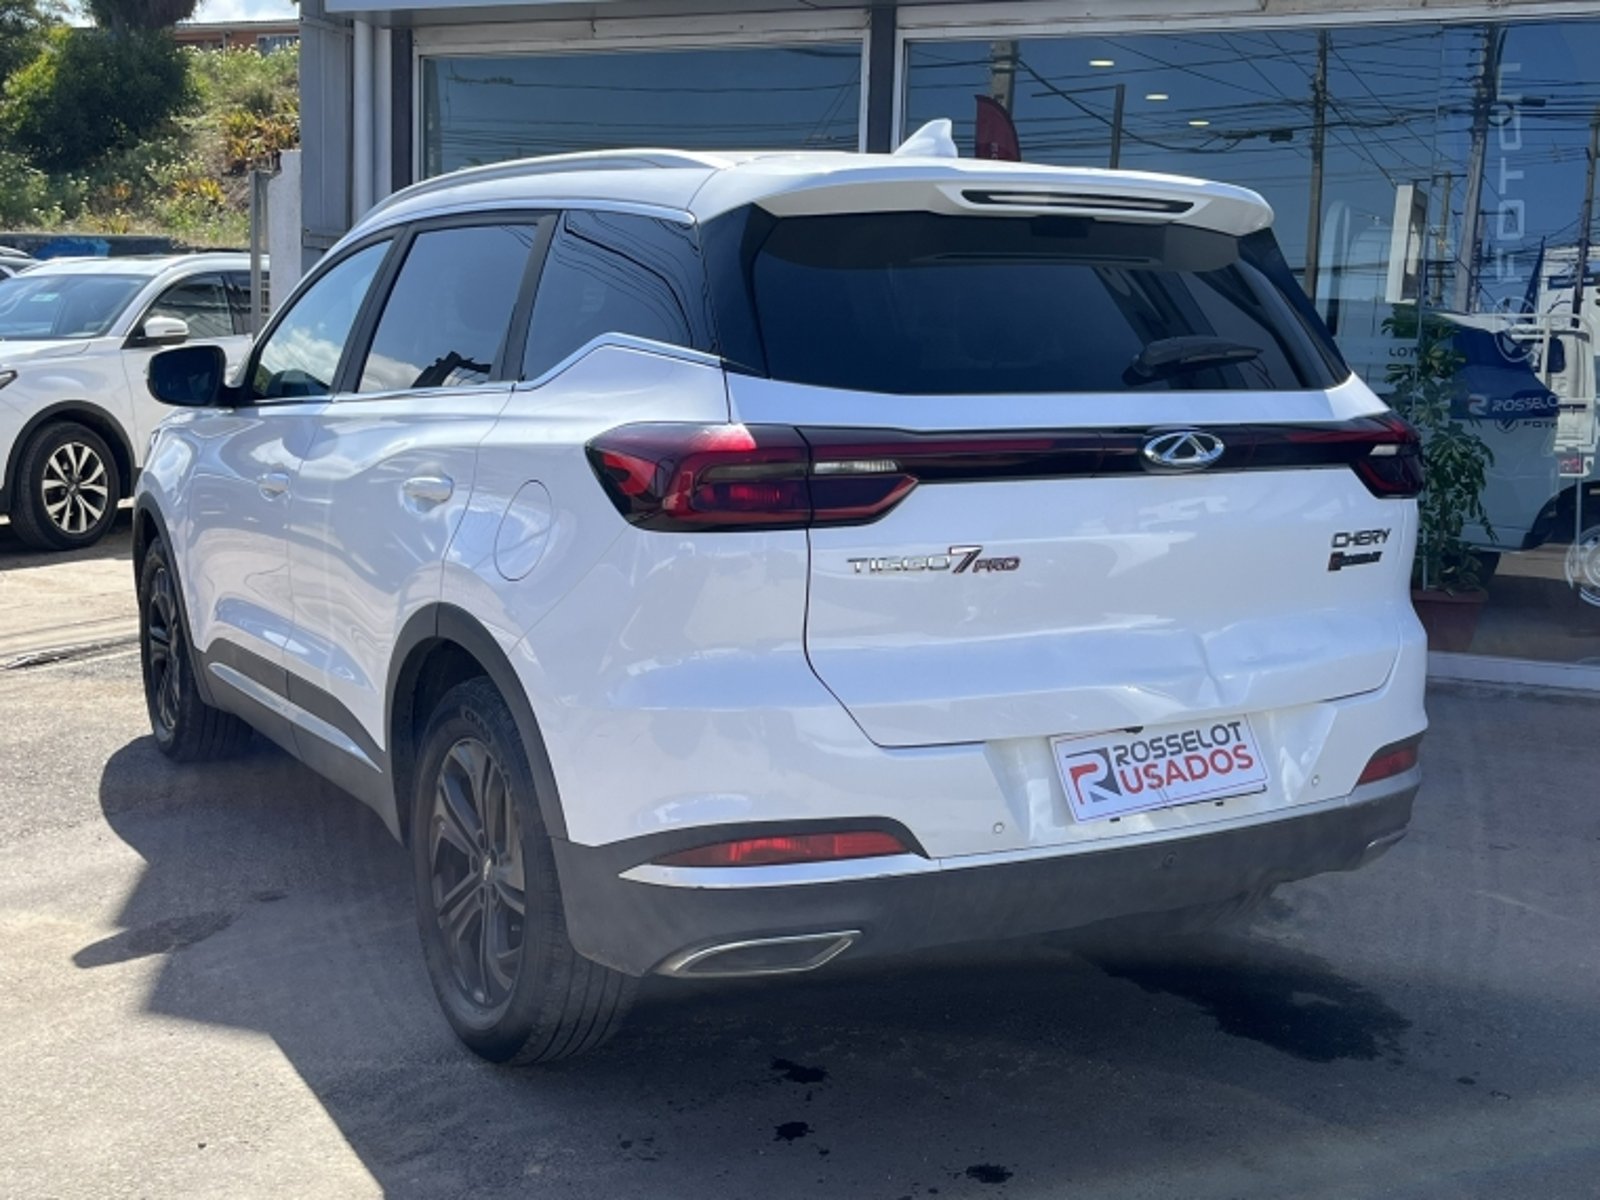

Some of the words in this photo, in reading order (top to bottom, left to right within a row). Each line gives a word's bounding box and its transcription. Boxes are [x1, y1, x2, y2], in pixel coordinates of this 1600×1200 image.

[1491, 394, 1559, 413] ROSSELO
[1331, 528, 1392, 548] CHERY
[847, 554, 950, 574] TIGGO
[949, 545, 983, 574] 7
[972, 556, 1021, 573] PRO
[1112, 721, 1242, 767] ROSSELOT
[1119, 744, 1254, 794] USADOS
